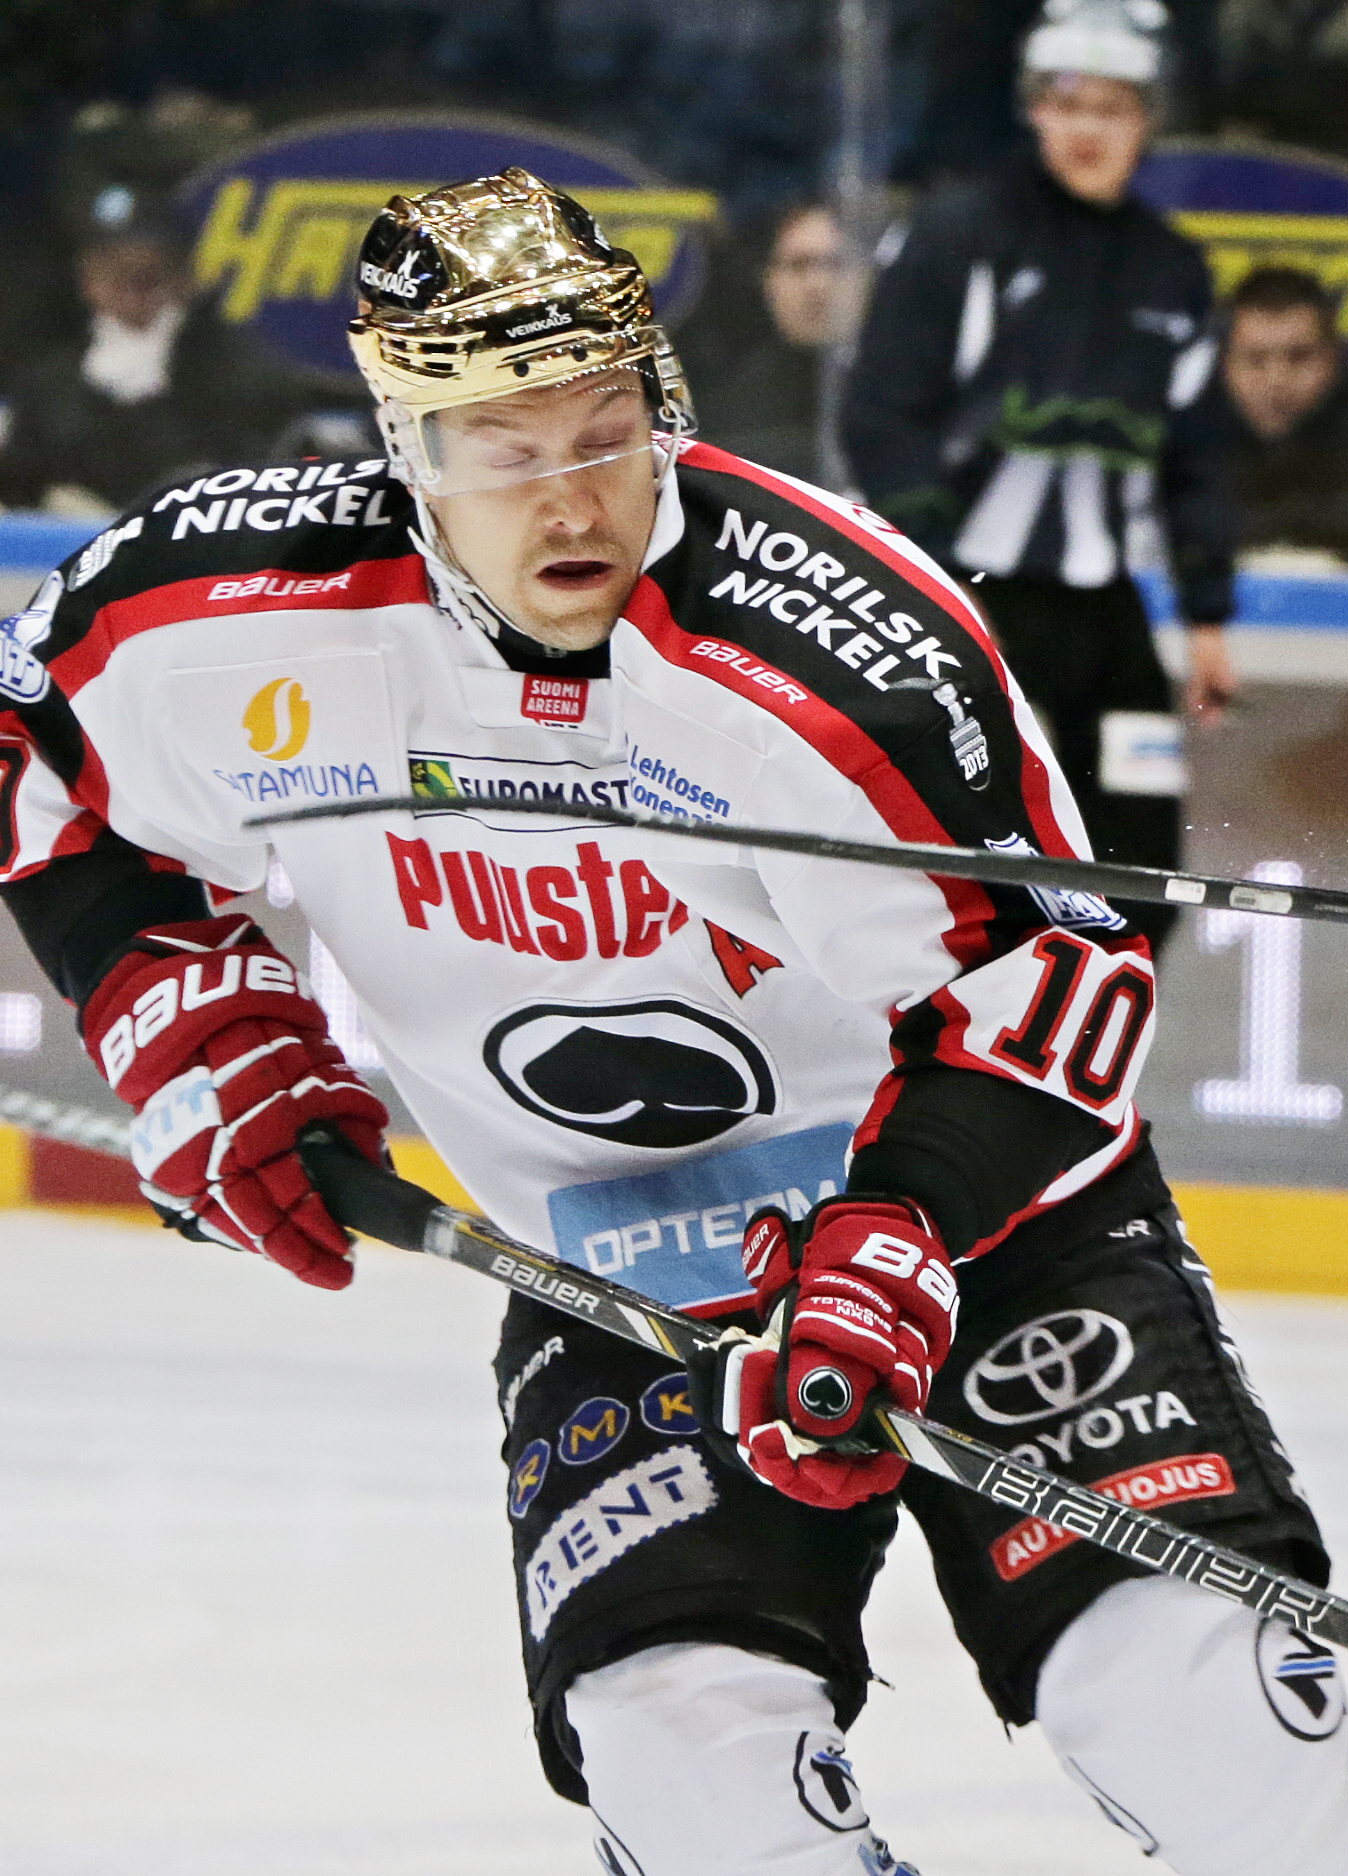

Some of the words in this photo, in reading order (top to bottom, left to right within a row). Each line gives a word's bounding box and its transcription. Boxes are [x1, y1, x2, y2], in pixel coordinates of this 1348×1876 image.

[506, 312, 573, 339] VEIKKAUS
[152, 458, 389, 513] NORILS
[171, 485, 392, 541] NICKEL
[714, 508, 962, 681] NORILSK
[708, 570, 904, 693] NICKEL
[525, 697, 580, 716] AREENA
[530, 679, 581, 699] SUOMI
[630, 745, 731, 818] Lehtosen
[958, 745, 989, 781] 2013
[99, 953, 307, 1091] BAUE
[988, 929, 1155, 1112] 10
[1009, 1390, 1198, 1470] OYOTA
